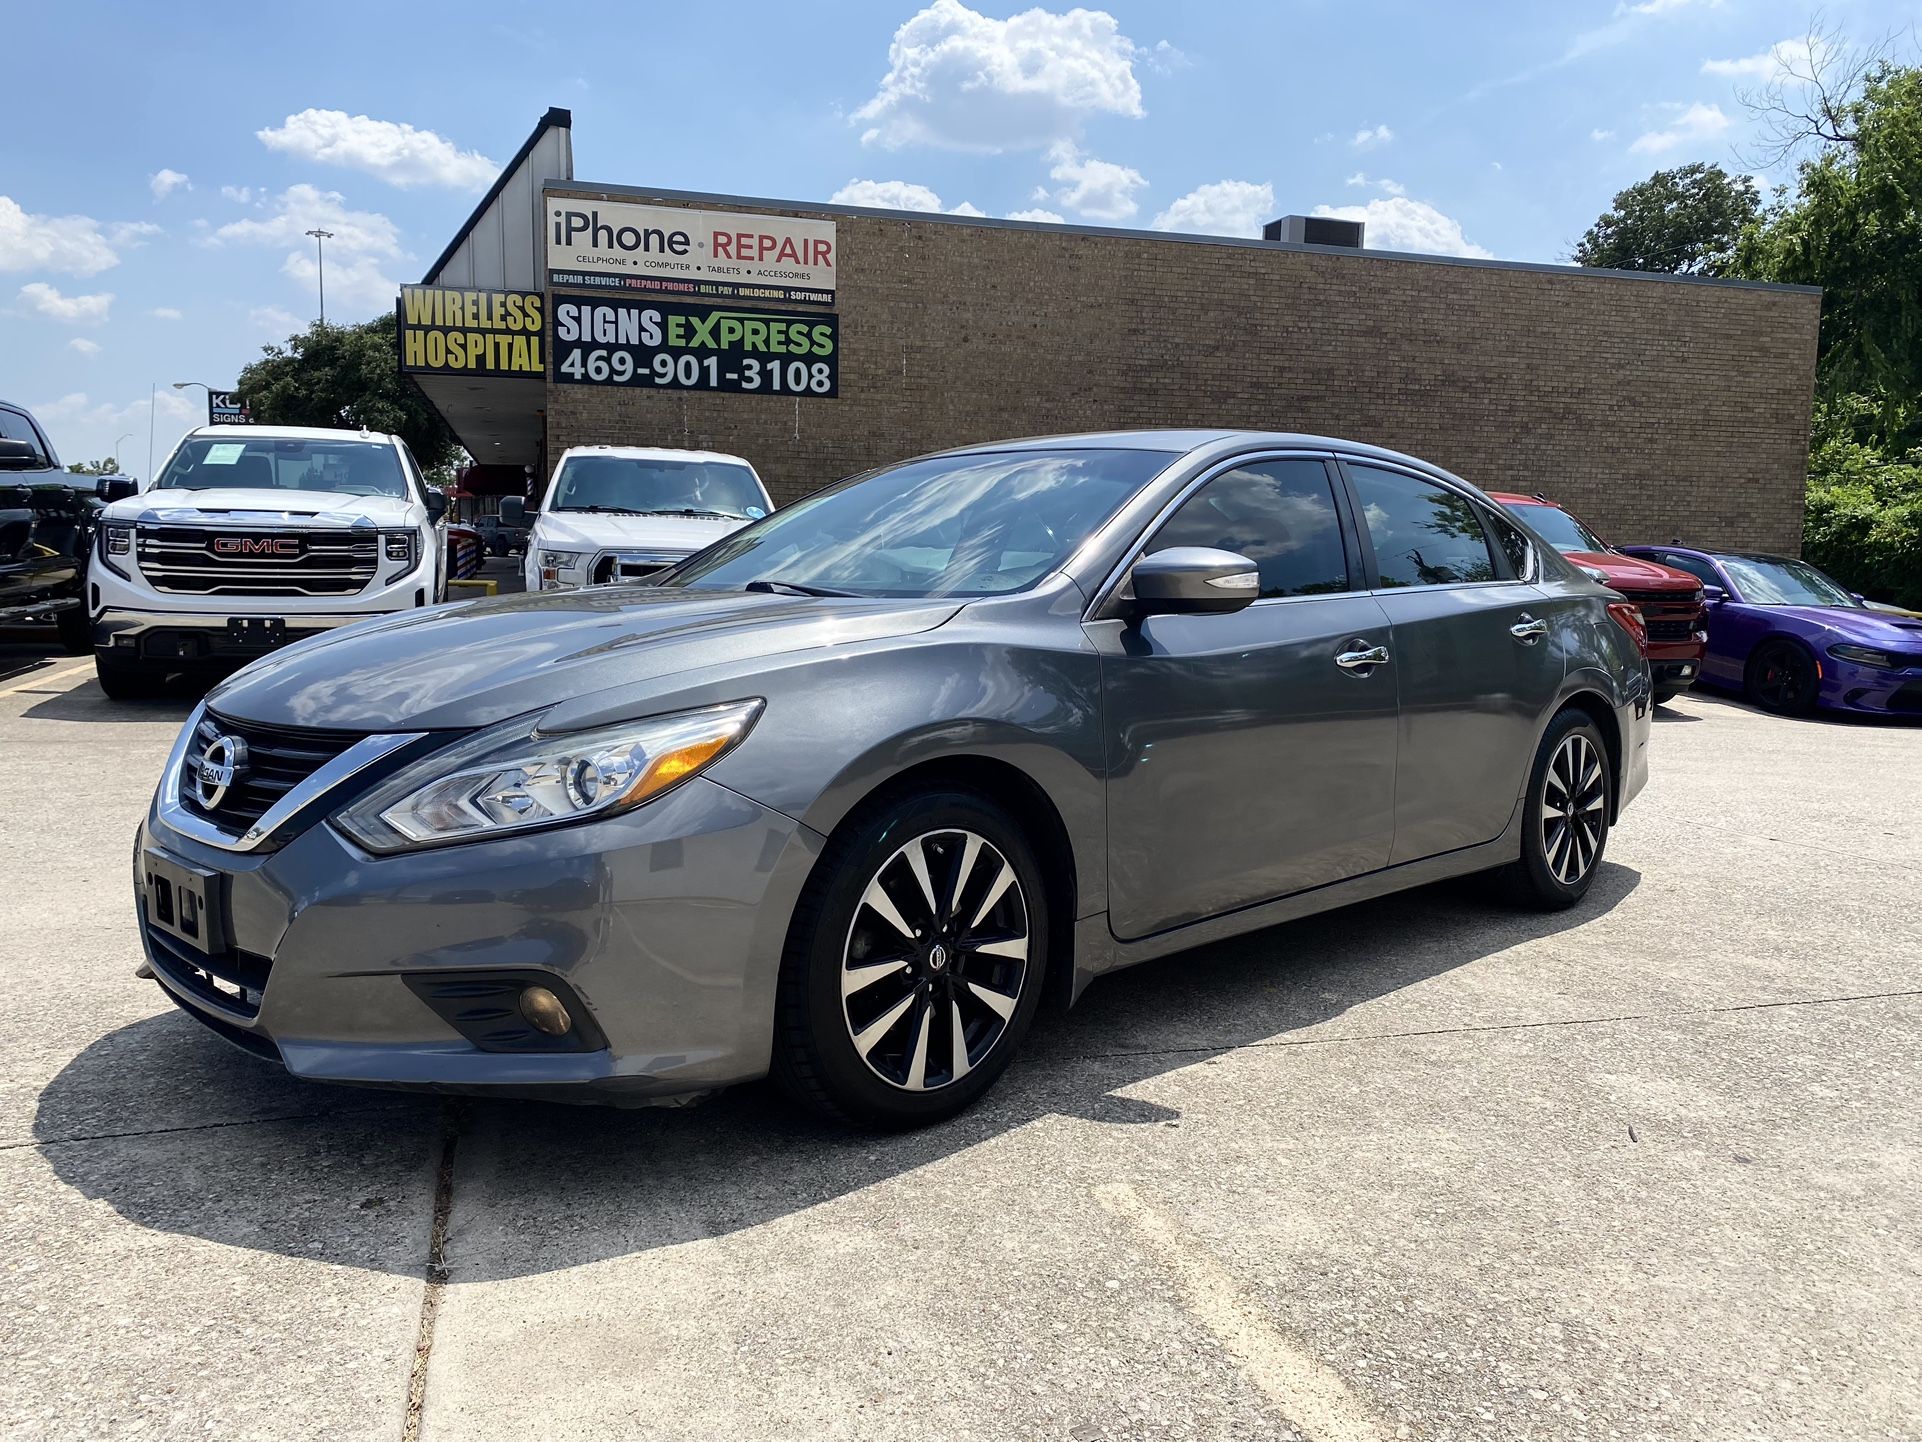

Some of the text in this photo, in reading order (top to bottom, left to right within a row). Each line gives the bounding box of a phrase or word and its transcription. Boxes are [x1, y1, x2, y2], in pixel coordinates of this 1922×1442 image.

[554, 210, 832, 267] iPhone REPAIR
[553, 274, 832, 302] REPAIR SERVICE PREPAID PHONES BILL PAY UNLOCKING SOFTWARE
[576, 255, 811, 280] CELLPHONE COMPUTER TABLETS ACCESSORIES
[403, 288, 542, 332] WIRELESS
[557, 303, 834, 356] SIGNS EXPRESS
[405, 329, 545, 372] HOSPITAL
[560, 348, 831, 394] 469-901-3108
[213, 413, 246, 423] SIGNS
[215, 537, 299, 554] GMC
